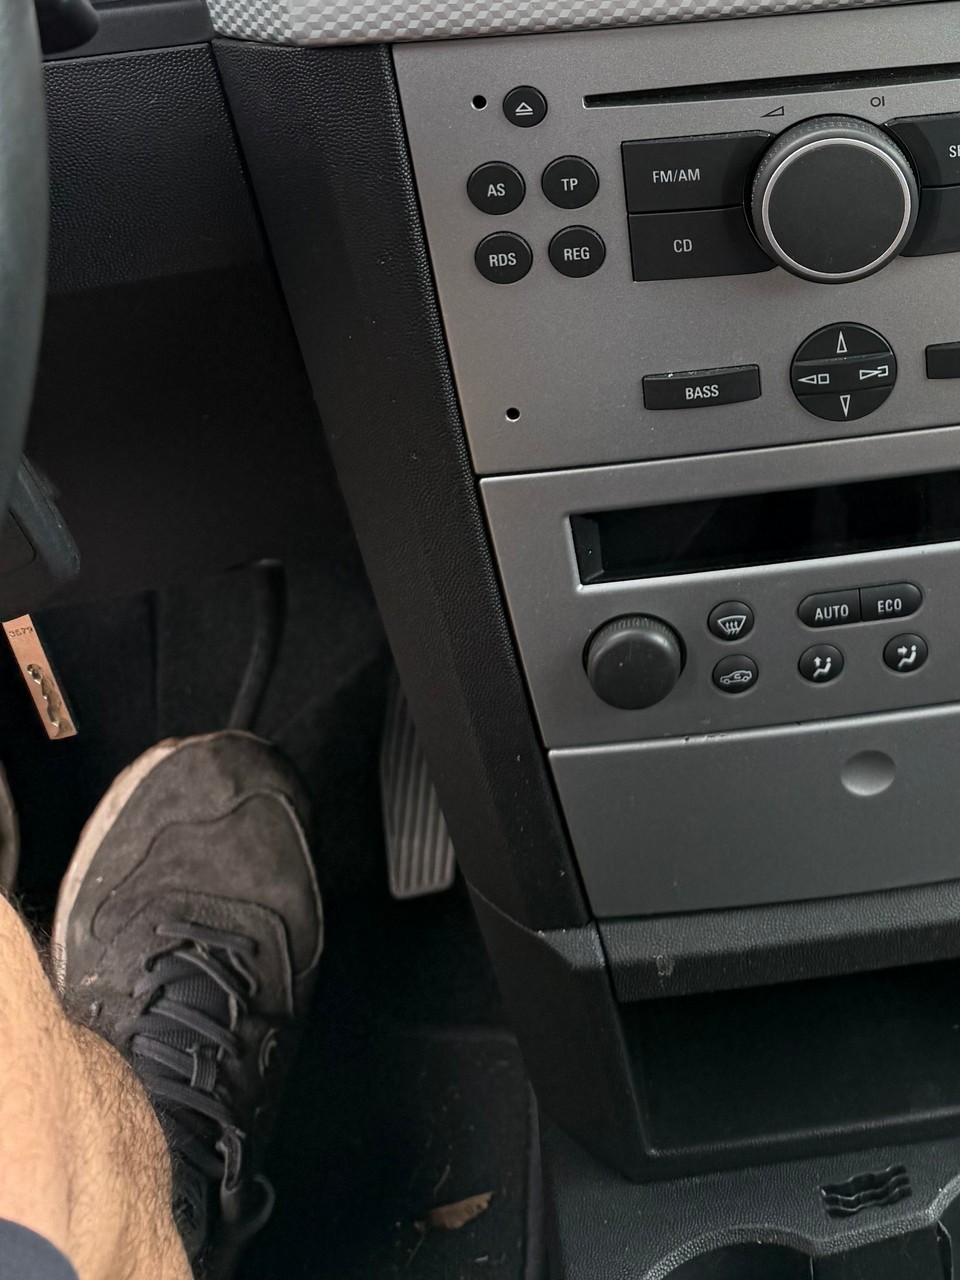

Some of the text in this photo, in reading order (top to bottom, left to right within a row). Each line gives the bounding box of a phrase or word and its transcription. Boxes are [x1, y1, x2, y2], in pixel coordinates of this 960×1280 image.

[652, 168, 701, 184] FM/AM
[486, 182, 506, 198] AS
[561, 177, 579, 192] TP
[673, 238, 692, 253] CD
[488, 252, 517, 268] RDS
[563, 246, 590, 262] REG
[685, 385, 719, 400] BASS
[815, 598, 902, 621] AUTO ECO
